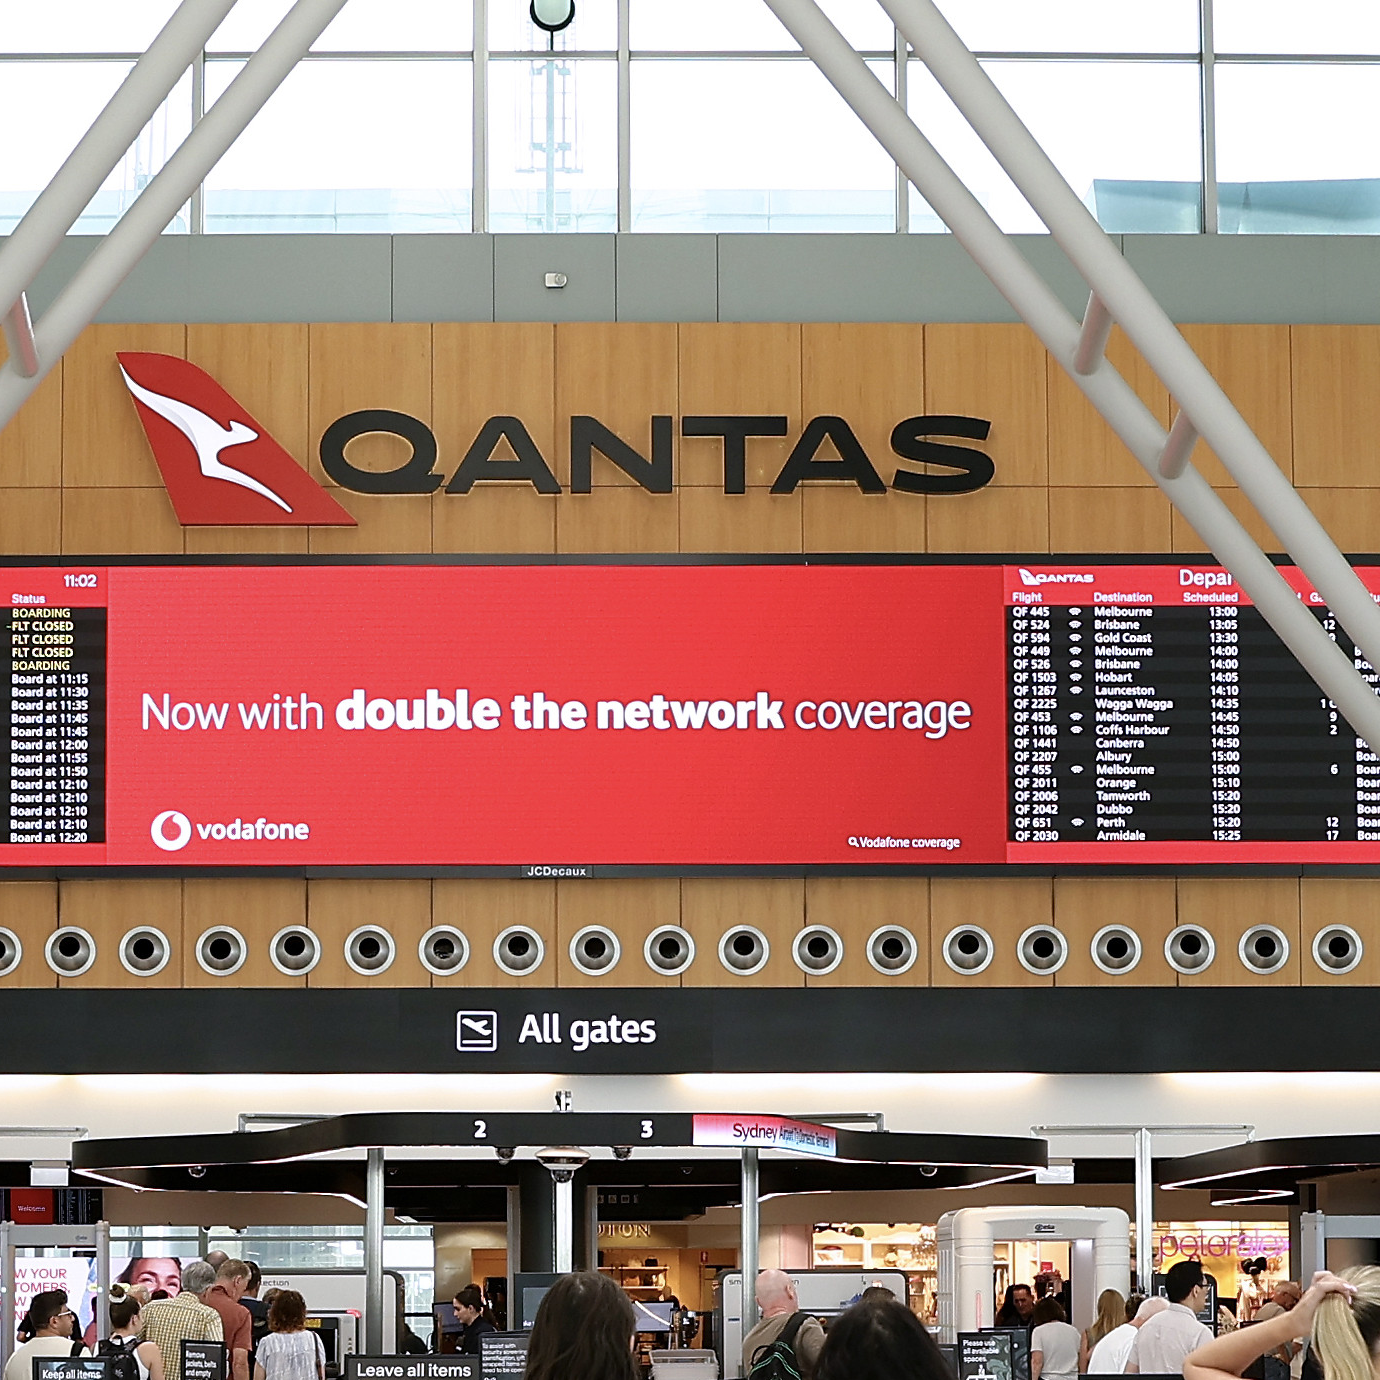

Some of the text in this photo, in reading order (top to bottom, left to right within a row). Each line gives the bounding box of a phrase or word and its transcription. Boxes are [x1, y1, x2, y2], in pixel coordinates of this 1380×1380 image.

[318, 408, 997, 497] QANTAS
[64, 574, 97, 587] 11:02
[1035, 574, 1094, 584] QANTAS
[12, 594, 45, 603] Status
[1013, 592, 1238, 604] Flight Destination Scheduled
[13, 608, 70, 618] BOARDING
[1013, 606, 1238, 617] QF 445 Melbourne 13:00
[1014, 685, 1239, 696] QF 1267 Launceston 14:10
[143, 689, 971, 738] Now with double the network coverage
[1014, 724, 1239, 736] QF 1106 Coffs Harbour 14:50
[11, 740, 42, 750] Board
[45, 741, 57, 750] at
[60, 740, 88, 750] 12:00
[11, 753, 42, 763] Board
[45, 754, 56, 763] at
[60, 753, 87, 763] 11:55
[197, 818, 309, 840] vodafone
[860, 837, 960, 850] Vodafone coverage
[528, 866, 586, 876] JCDecaux
[519, 1013, 656, 1051] All gates
[475, 1120, 486, 1138] 2
[641, 1121, 653, 1138] 3
[733, 1122, 779, 1142] Sydney
[31, 1269, 67, 1279] YOUR
[43, 1367, 103, 1380] Keep all items
[358, 1363, 471, 1377] Leave all items
